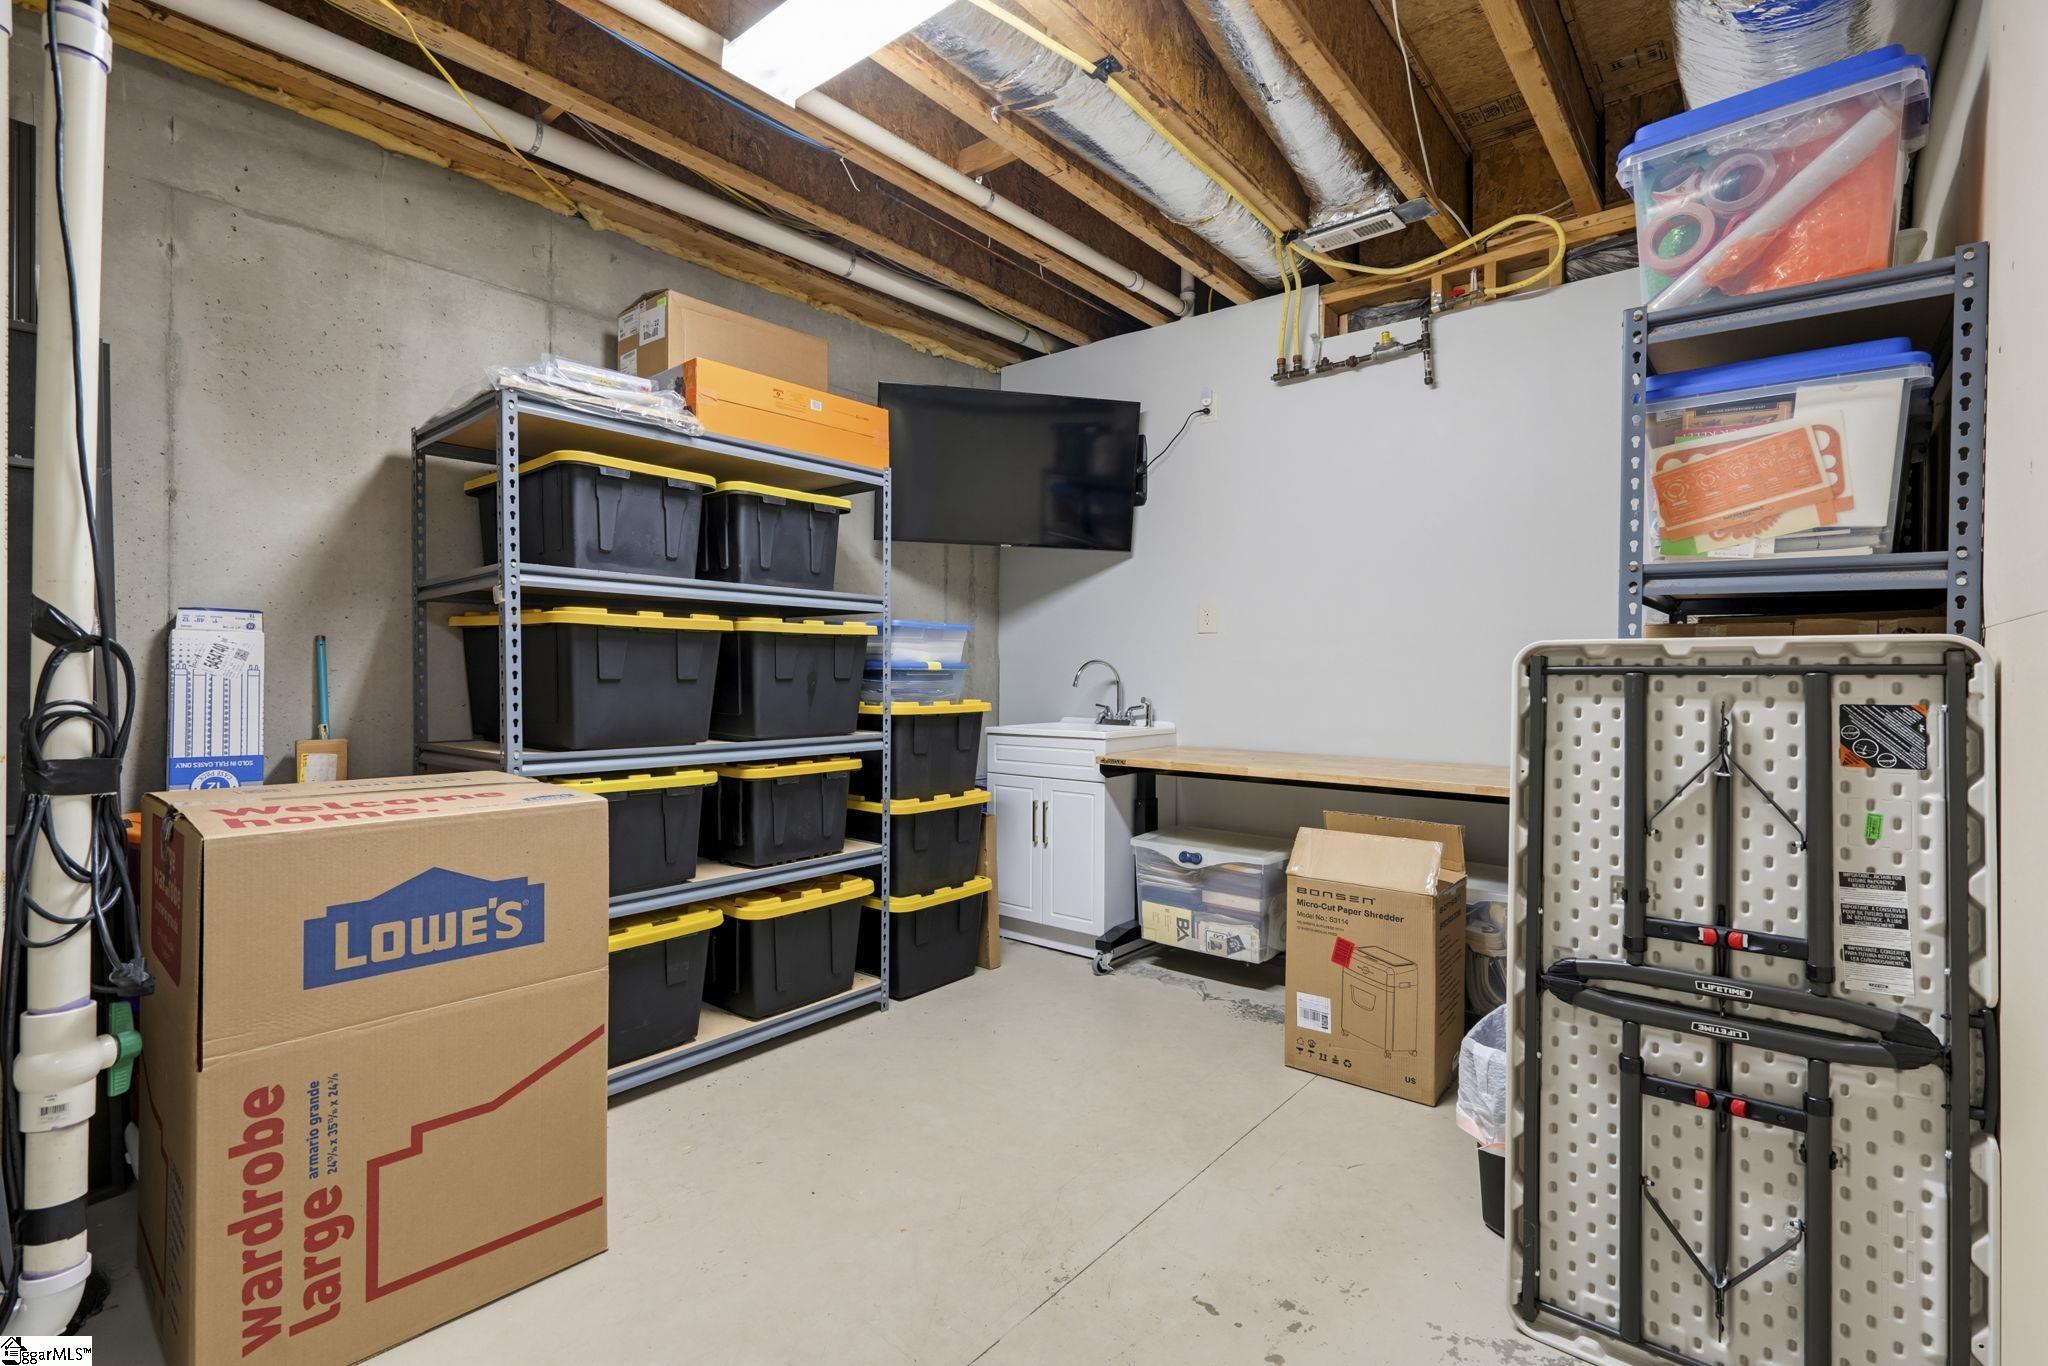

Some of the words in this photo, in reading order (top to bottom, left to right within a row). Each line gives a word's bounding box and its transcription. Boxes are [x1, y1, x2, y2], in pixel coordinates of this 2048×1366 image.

[210, 790, 506, 817] Welcome
[223, 807, 439, 829] home.
[1297, 886, 1374, 906] BONSEN
[1297, 898, 1335, 912] Micro-Cut
[1337, 905, 1362, 917] Paper
[1364, 909, 1405, 923] Shredder
[1297, 911, 1314, 920] Model
[335, 897, 524, 971] LOWE'S
[1701, 983, 1746, 997] LIFETIME
[1697, 1024, 1743, 1038] LIFETIME
[1404, 1076, 1416, 1085] US
[307, 1080, 322, 1126] grande
[306, 1128, 320, 1179] armario
[227, 1083, 286, 1359] wardrobe
[289, 1183, 355, 1338] large
